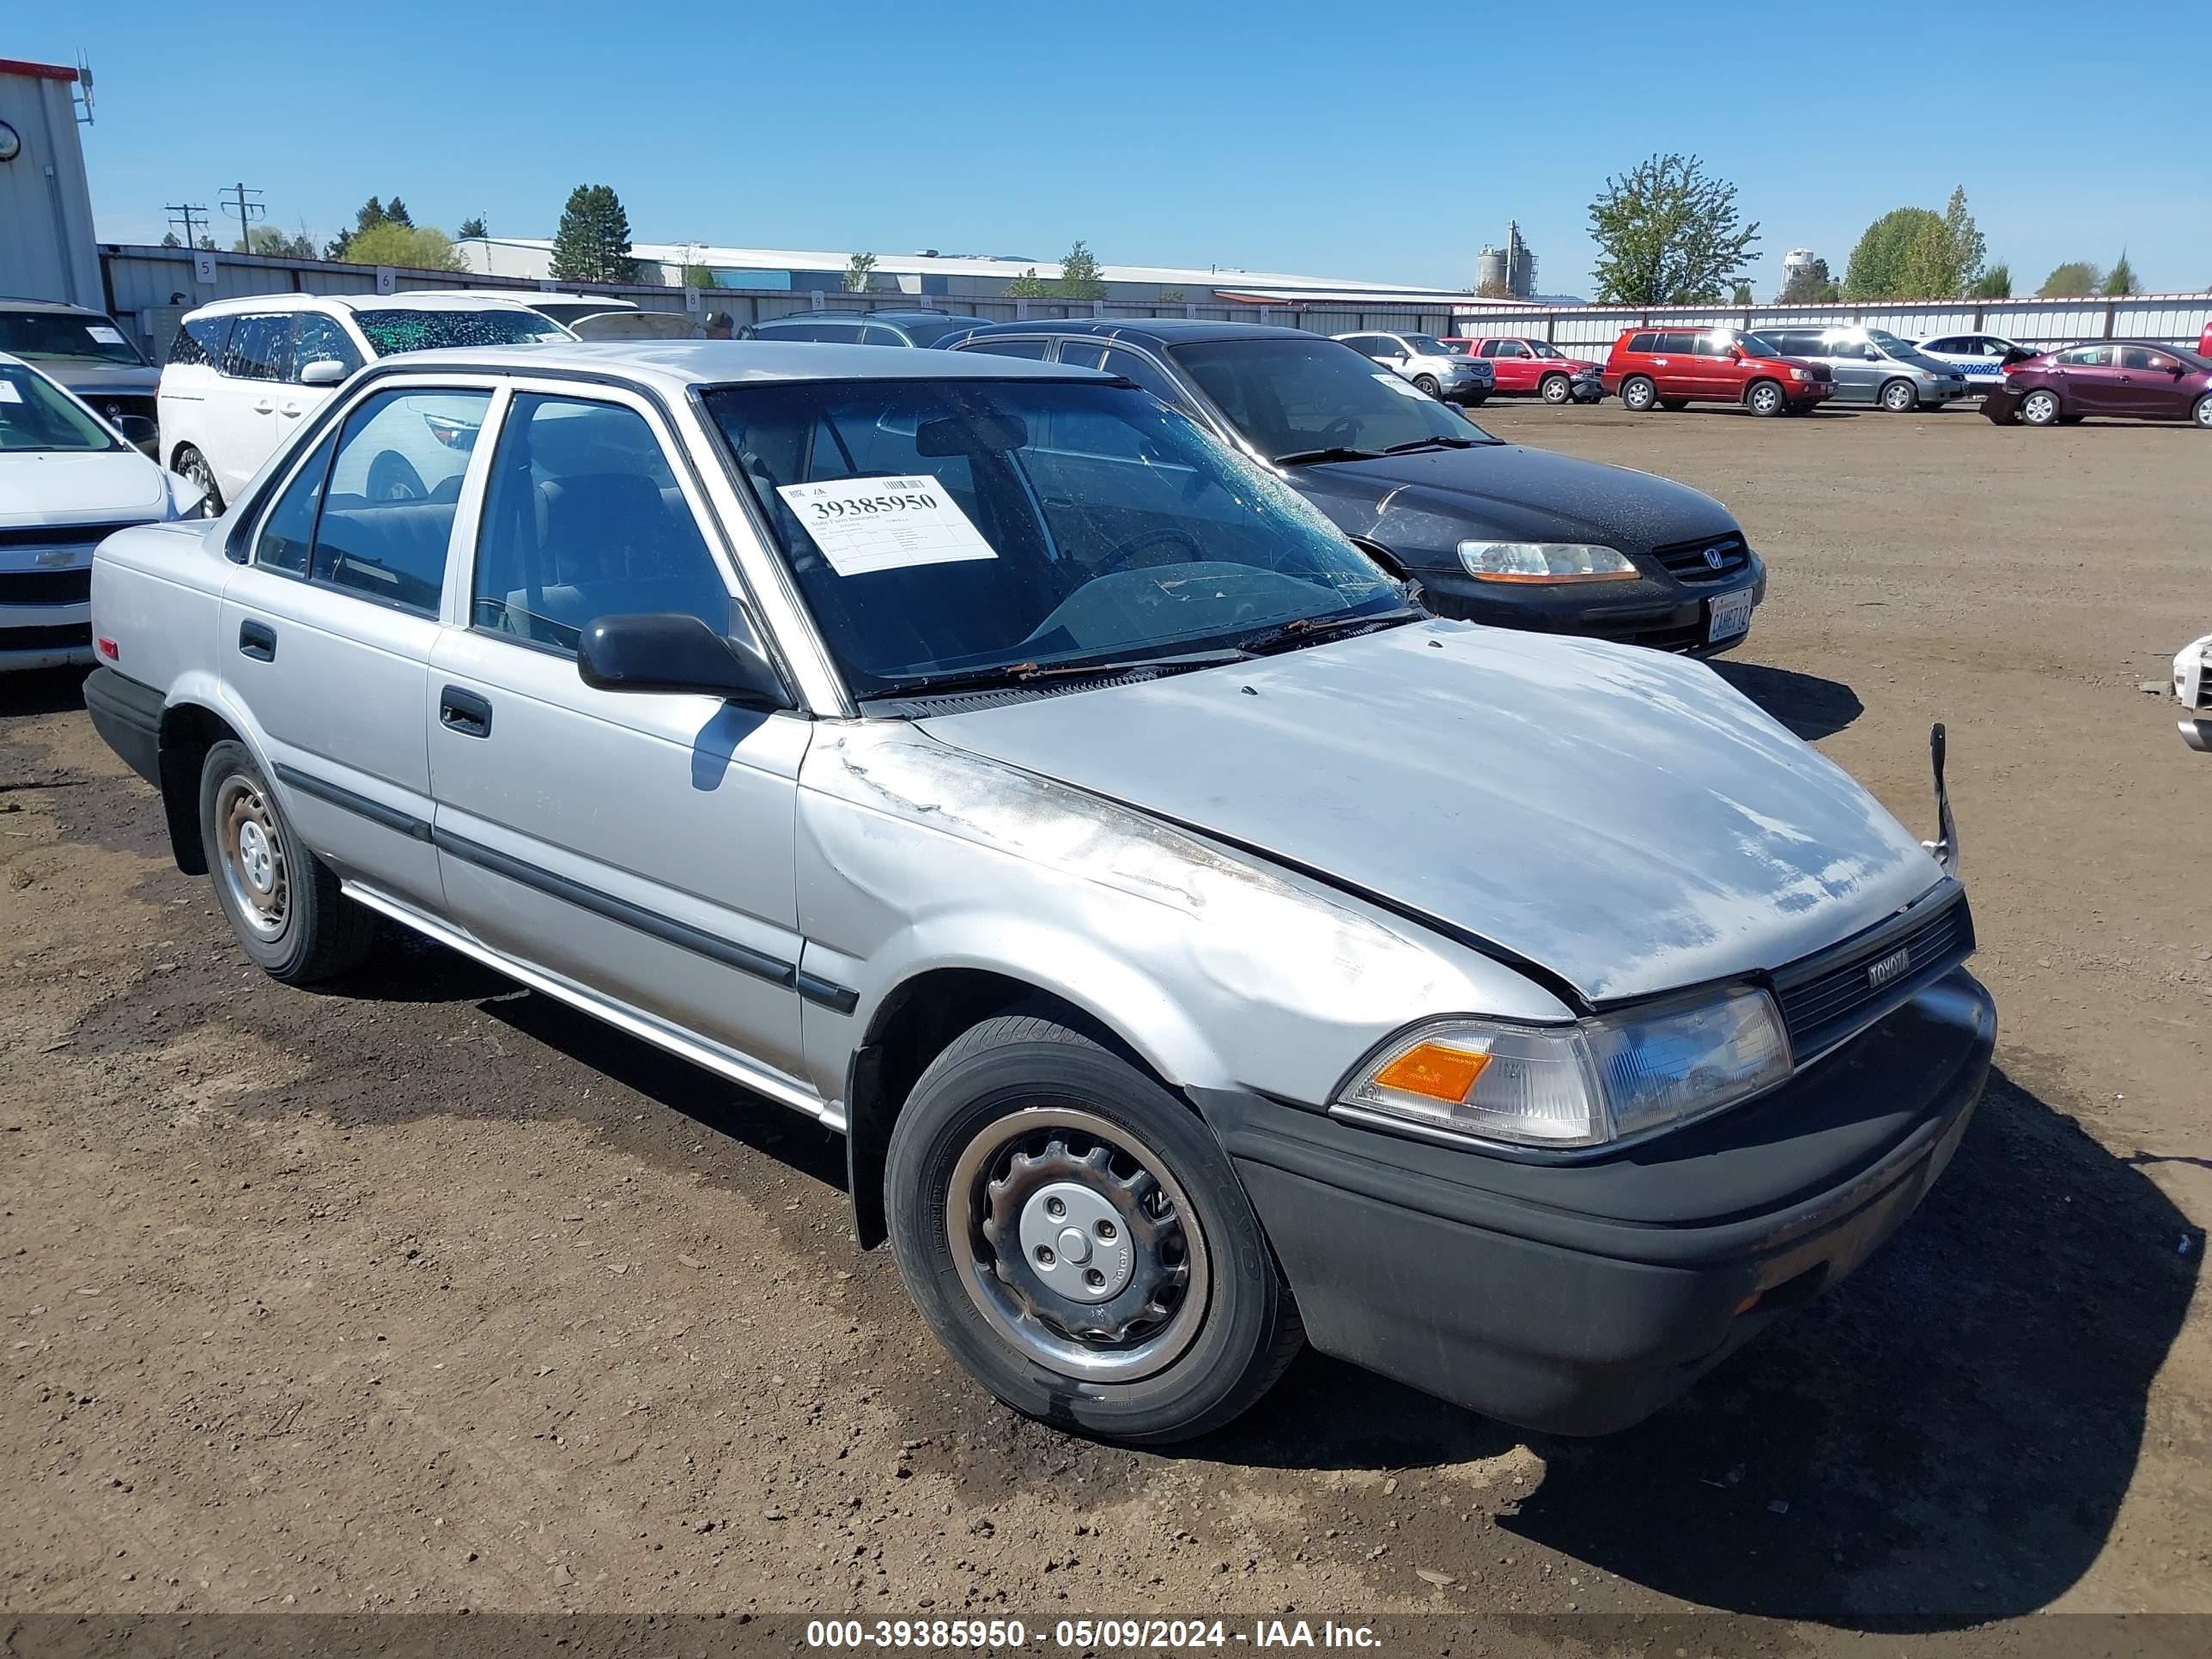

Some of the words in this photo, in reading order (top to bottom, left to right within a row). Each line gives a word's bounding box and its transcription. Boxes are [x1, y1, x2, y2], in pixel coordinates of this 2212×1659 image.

[201, 261, 210, 275] 5
[382, 275, 390, 287] 6
[690, 294, 696, 305] 8
[815, 296, 821, 307] 9
[1095, 306, 1103, 315] 12
[810, 494, 938, 520] 39385950
[1712, 605, 1749, 634] CAH6712
[1869, 951, 1910, 987] TOYOTA
[1112, 1247, 1127, 1284] TOYOTA
